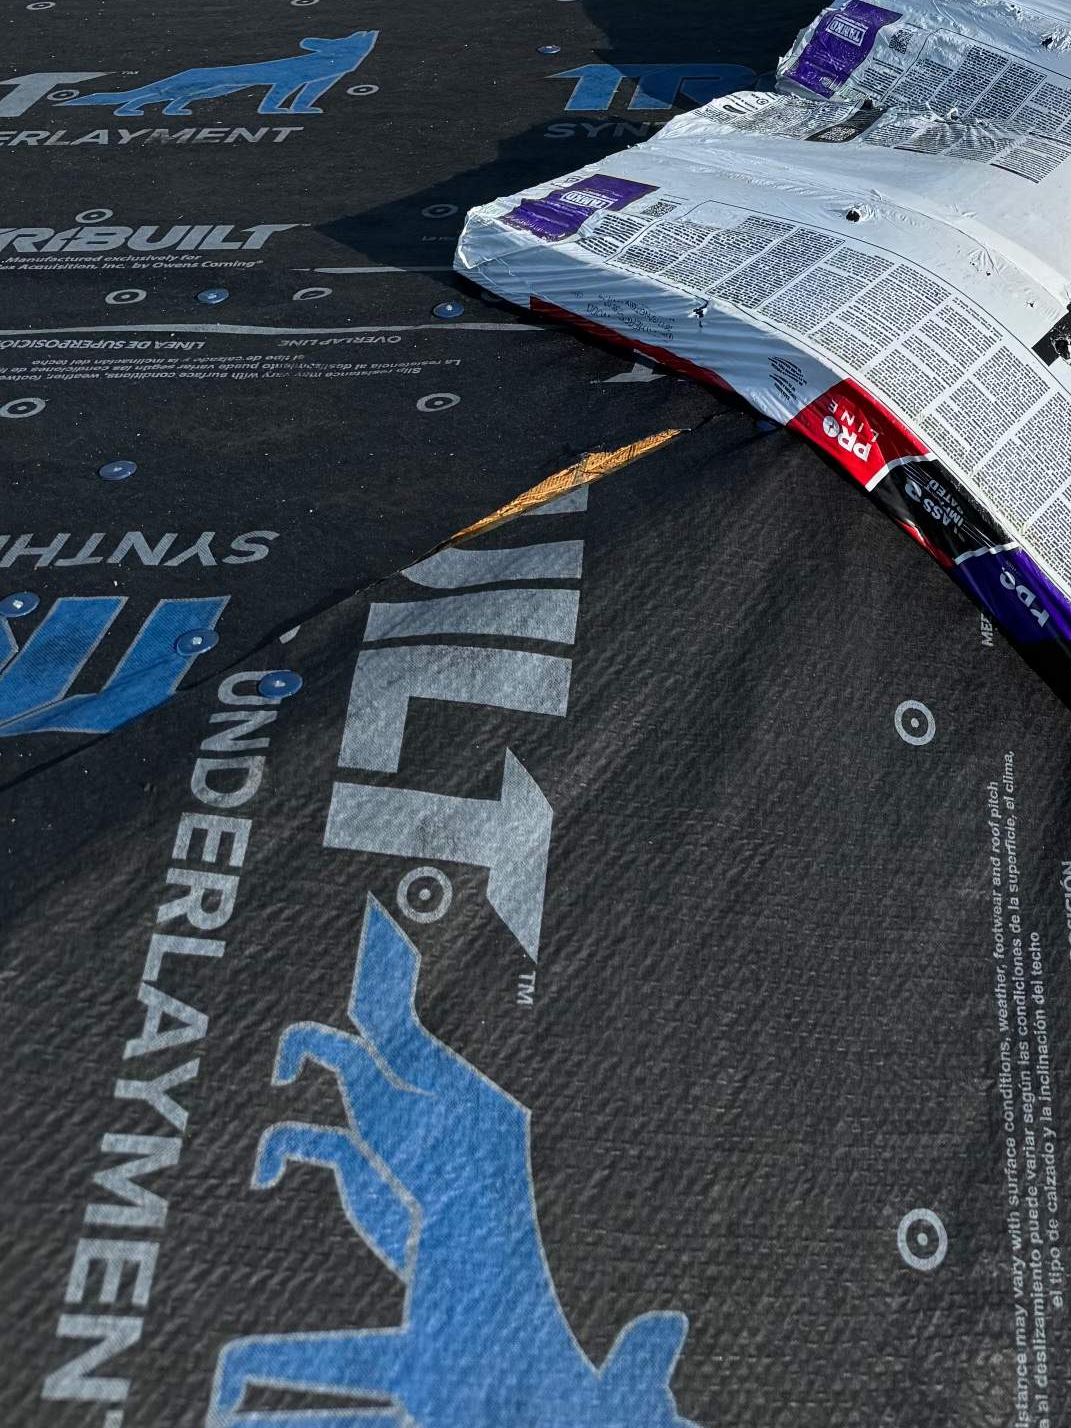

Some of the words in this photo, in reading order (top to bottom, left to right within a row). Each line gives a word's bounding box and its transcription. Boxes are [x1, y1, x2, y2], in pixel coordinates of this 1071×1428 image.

[152, 259, 199, 268] Owens
[0, 339, 126, 349] SUPERPOSICIÓ
[124, 340, 151, 349] DE
[154, 340, 205, 350] LÍNEA
[318, 335, 401, 345] OVERLAP
[820, 412, 877, 466] PRO
[1002, 750, 1014, 793] clima,
[986, 781, 1002, 818] pitch
[1003, 795, 1015, 810] el
[988, 820, 1007, 853] roof
[1004, 814, 1020, 892] superficie,
[990, 855, 1001, 886] and
[1007, 896, 1020, 910] la
[991, 889, 1011, 958] footwear
[1008, 914, 1022, 933] de
[1028, 931, 1043, 975] techo
[995, 964, 1009, 1032] weather,
[1012, 938, 1028, 1036] condiciones
[1030, 980, 1045, 1004] del
[1017, 1041, 1030, 1065] las
[1033, 1009, 1051, 1101] inclinación
[999, 1036, 1015, 1132] conditions,
[1018, 1070, 1036, 1123] según
[1039, 1106, 1053, 1121] la
[1043, 1126, 1057, 1137] y
[1004, 1137, 1019, 1206] surface
[1022, 1127, 1037, 1180] variar
[1041, 1141, 1058, 1213] calzado
[1007, 1211, 1022, 1251] with
[1025, 1185, 1044, 1244] puede
[1046, 1218, 1059, 1241] de
[1012, 1255, 1026, 1298] vary
[1048, 1246, 1064, 1284] tipo
[1029, 1248, 1048, 1387] deslizamiento
[1049, 1290, 1063, 1308] el
[1014, 1304, 1028, 1346] may
[1034, 1394, 1049, 1412] al
